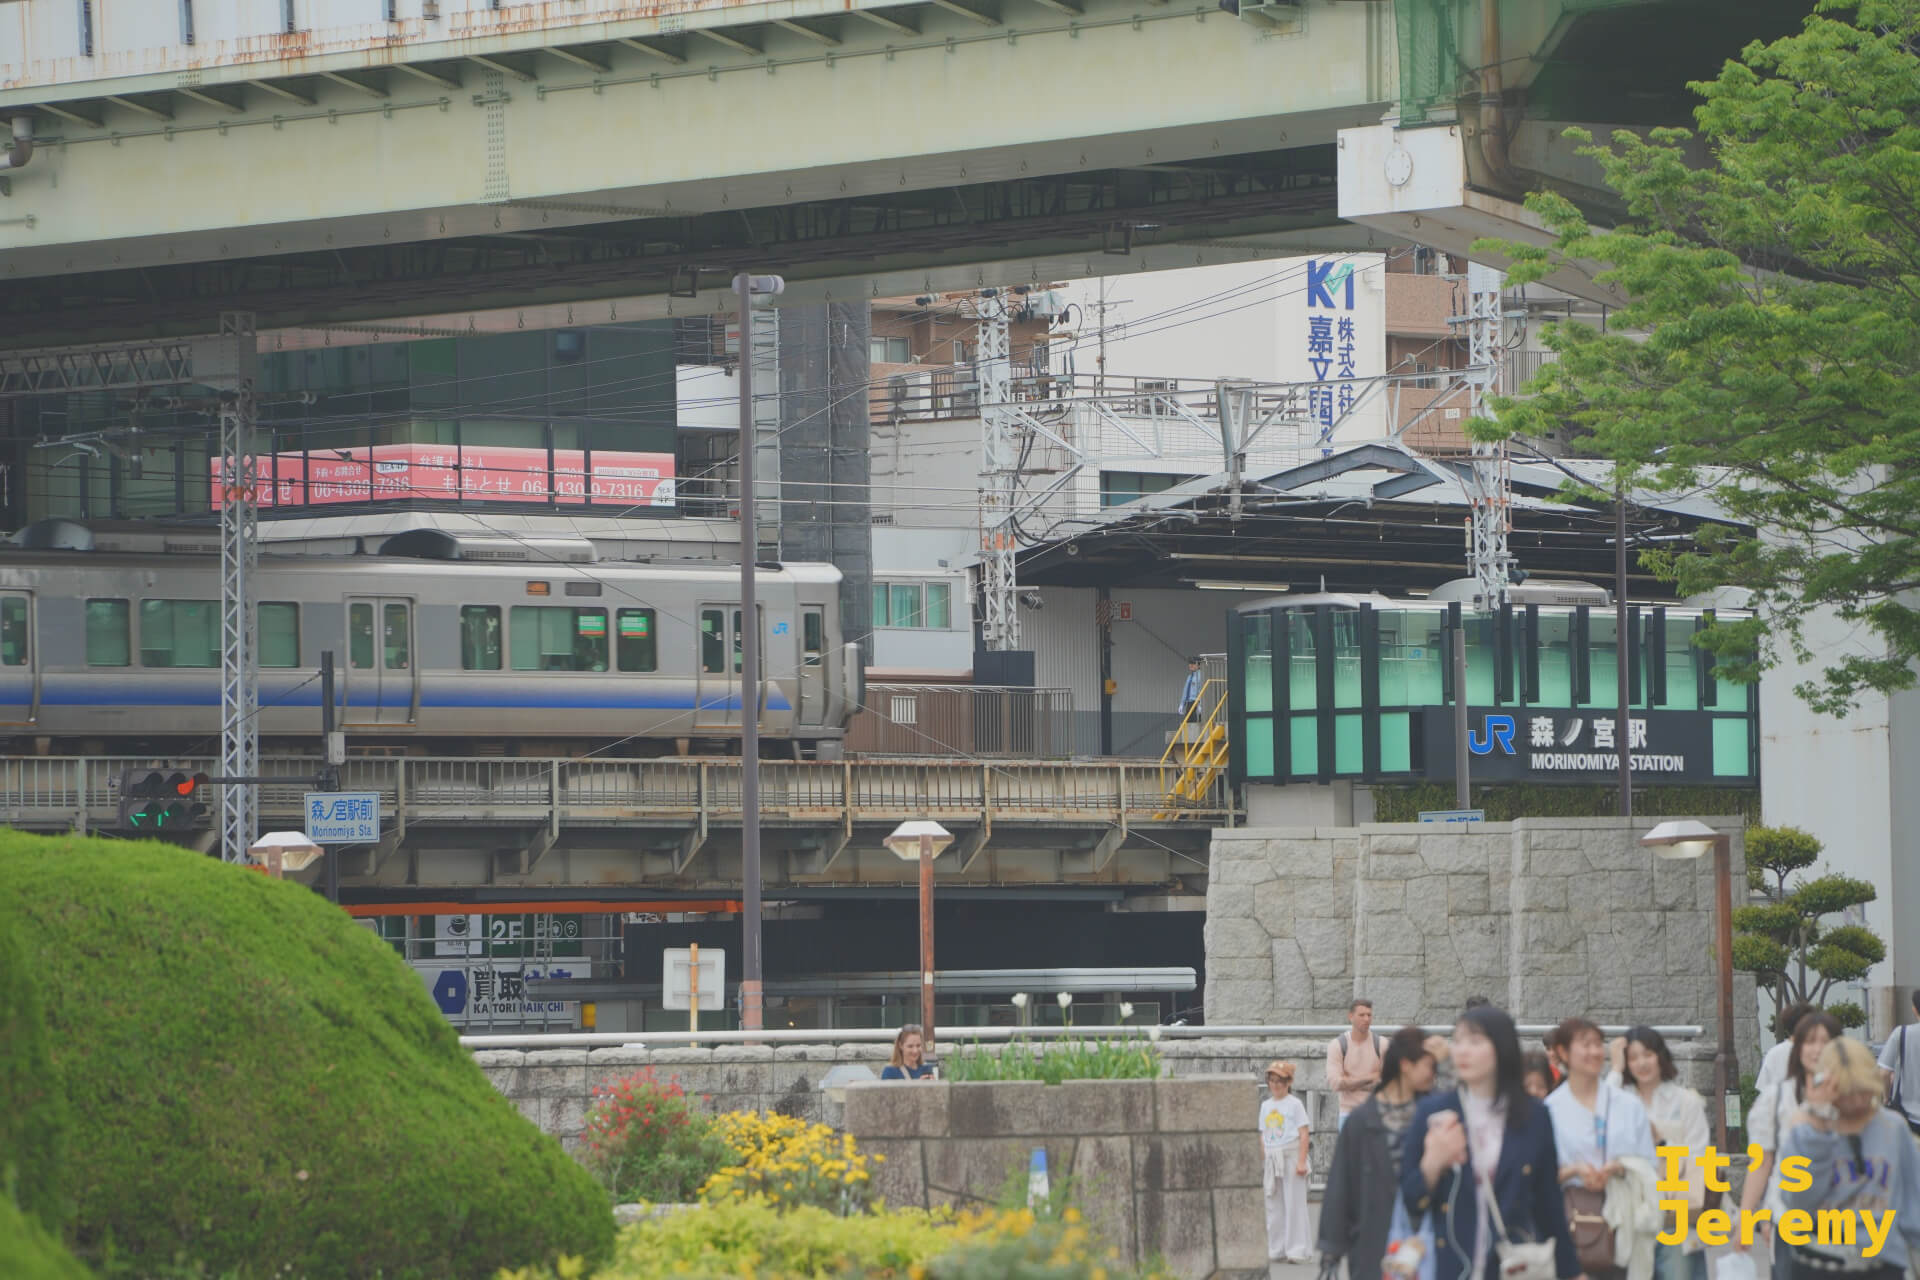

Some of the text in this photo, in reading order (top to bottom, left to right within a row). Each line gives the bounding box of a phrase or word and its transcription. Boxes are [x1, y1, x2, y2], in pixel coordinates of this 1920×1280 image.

[1337, 316, 1355, 415] 株式会社
[522, 480, 643, 499] 06-4309-7316
[773, 622, 789, 635] JR
[1468, 715, 1516, 754] JR
[1531, 716, 1647, 748] 森ノ宮駅
[1531, 753, 1684, 772] MORINOMIYA STATION
[312, 799, 373, 821] 森ノ宮駅前
[312, 825, 355, 838] Morinomiya
[492, 920, 522, 944] 2F
